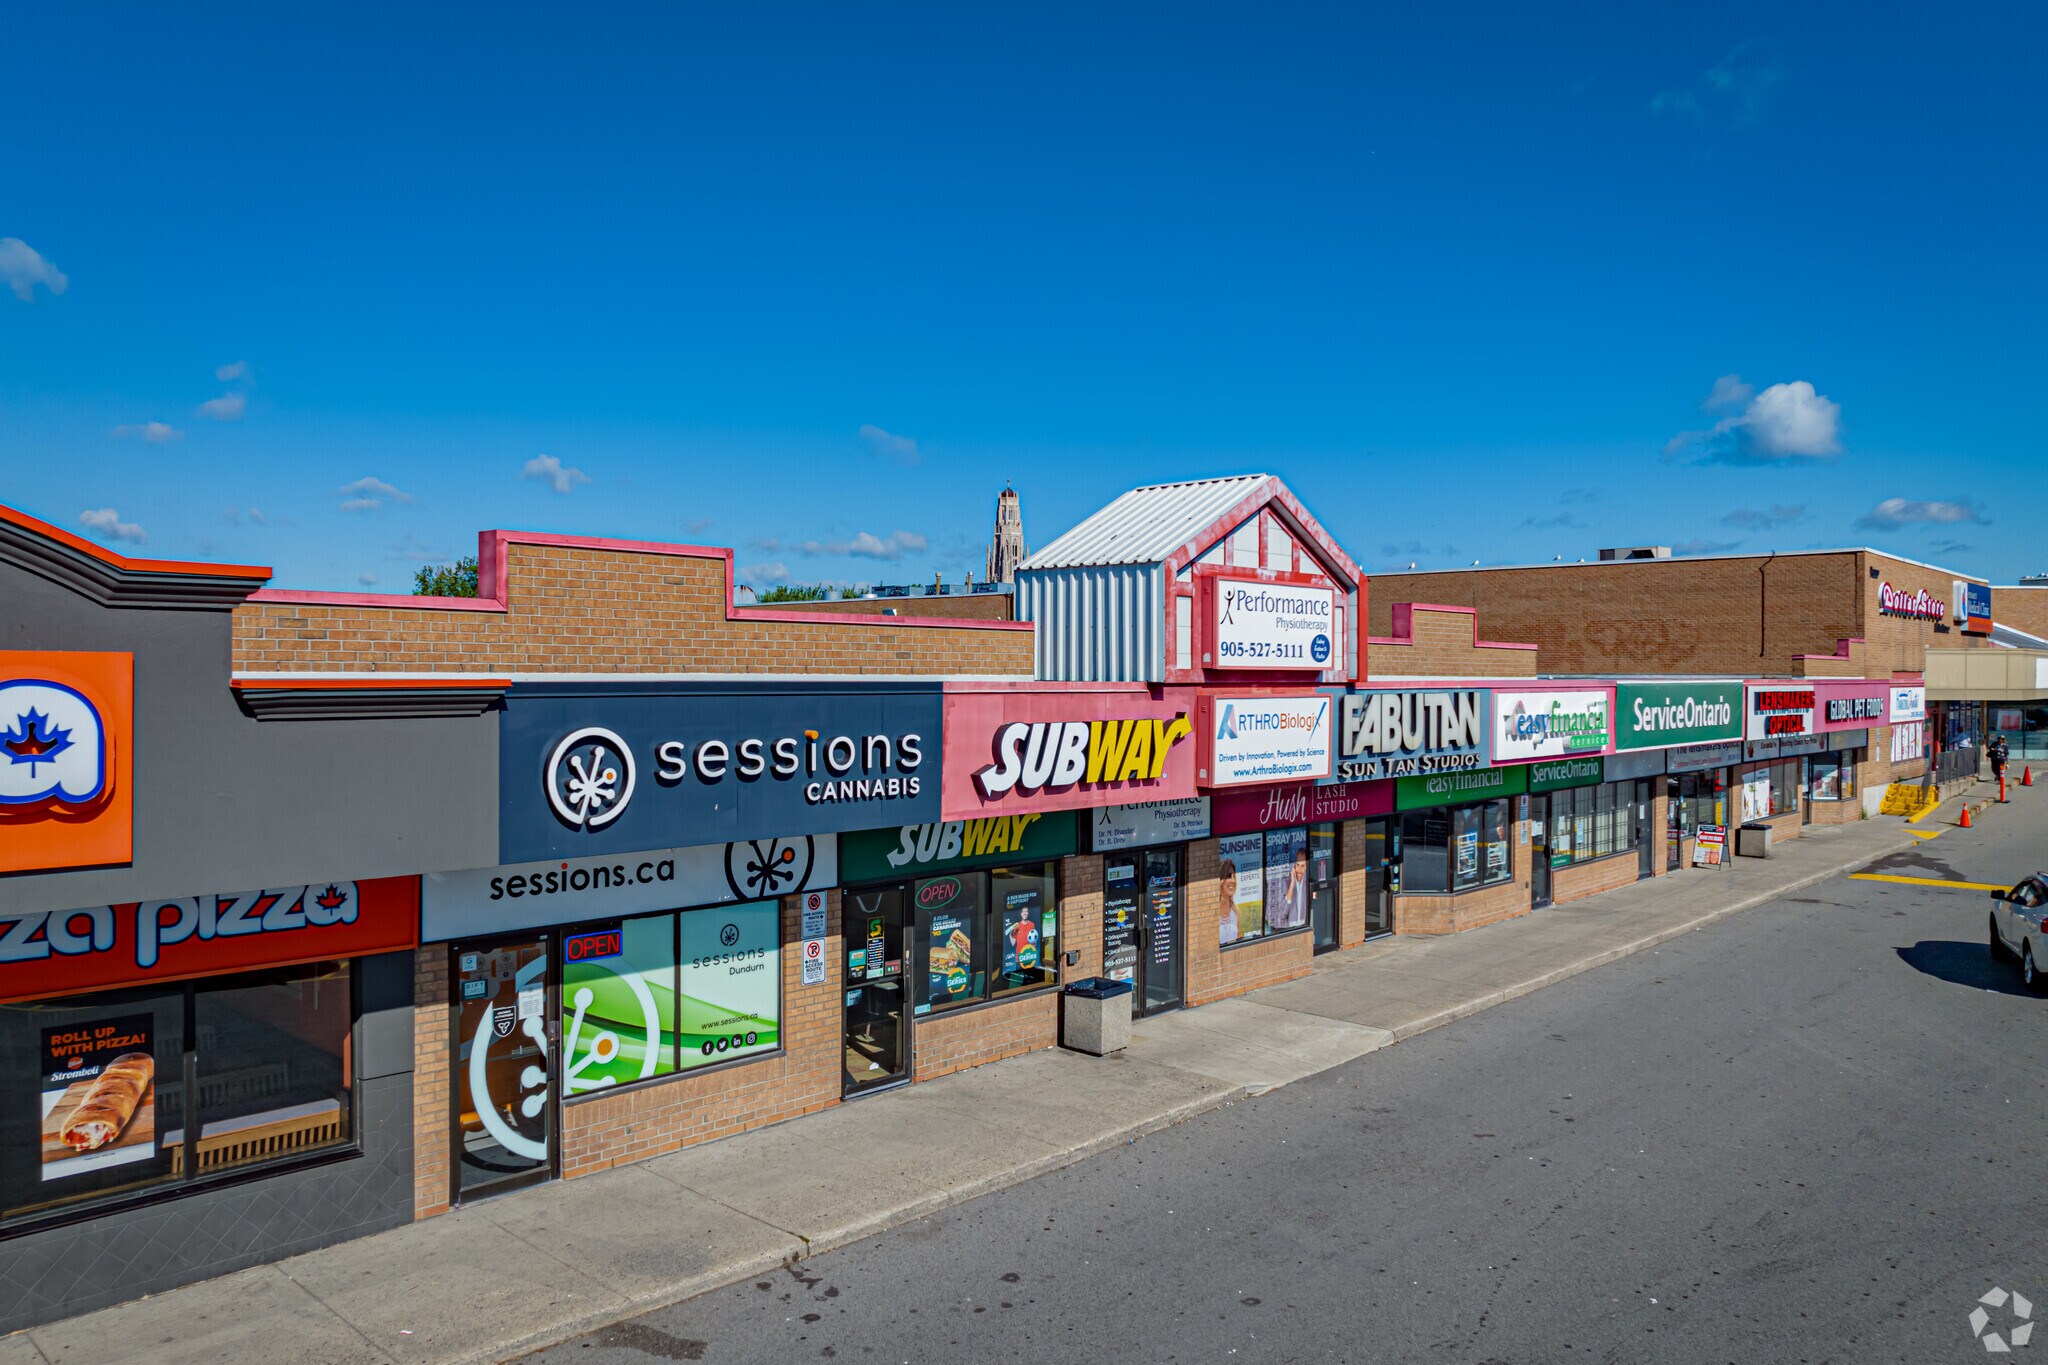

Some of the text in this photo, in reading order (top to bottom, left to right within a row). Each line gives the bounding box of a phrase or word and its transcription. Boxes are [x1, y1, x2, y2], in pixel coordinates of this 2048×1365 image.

[1237, 590, 1329, 616] Performance
[1882, 582, 1944, 617] Dollar Store
[1276, 617, 1328, 633] Physiotherapy
[1221, 641, 1304, 658] 905-527-5111
[1758, 691, 1815, 711] LENSMAKERS
[1830, 699, 1853, 719] GLOBAL
[1854, 699, 1865, 718] PET
[1867, 698, 1883, 717] FOODS
[1342, 692, 1480, 757] FABUTAN
[1633, 696, 1731, 733] ServiceOntario
[1768, 714, 1806, 735] OPTICAL
[1571, 734, 1609, 747] services
[658, 730, 922, 780] sessions
[980, 712, 1192, 797] SUBWAY
[1219, 748, 1325, 762] Driven by Innovation, Powered by Science
[1233, 762, 1312, 776] www.ArthroBiologix.com
[1342, 754, 1480, 778] SUN TAN STUDIOS
[1533, 758, 1599, 783] ServiceOntario
[807, 778, 920, 802] CANNABIS
[1317, 785, 1347, 799] LASH
[1155, 808, 1201, 821] Physiotherapy
[1260, 786, 1306, 824] Hush
[1317, 798, 1358, 815] STUDIO
[886, 813, 1041, 869] SUBWAY
[1220, 838, 1261, 855] SUNSHINE
[1266, 830, 1306, 847] SPRAY TAN
[490, 859, 675, 900] sessions.ca
[921, 884, 955, 902] OPEN
[136, 880, 360, 968] pizza
[568, 933, 621, 961] OPEN
[693, 948, 765, 969] sessions
[729, 963, 765, 975] Dundurn
[1104, 956, 1136, 967] 905-527-5111
[701, 1013, 758, 1029] www.sessions.ca
[51, 1026, 116, 1045] ROLL UP
[51, 1033, 146, 1058] WITH PIZZA!
[51, 1065, 100, 1082] Stromboli
